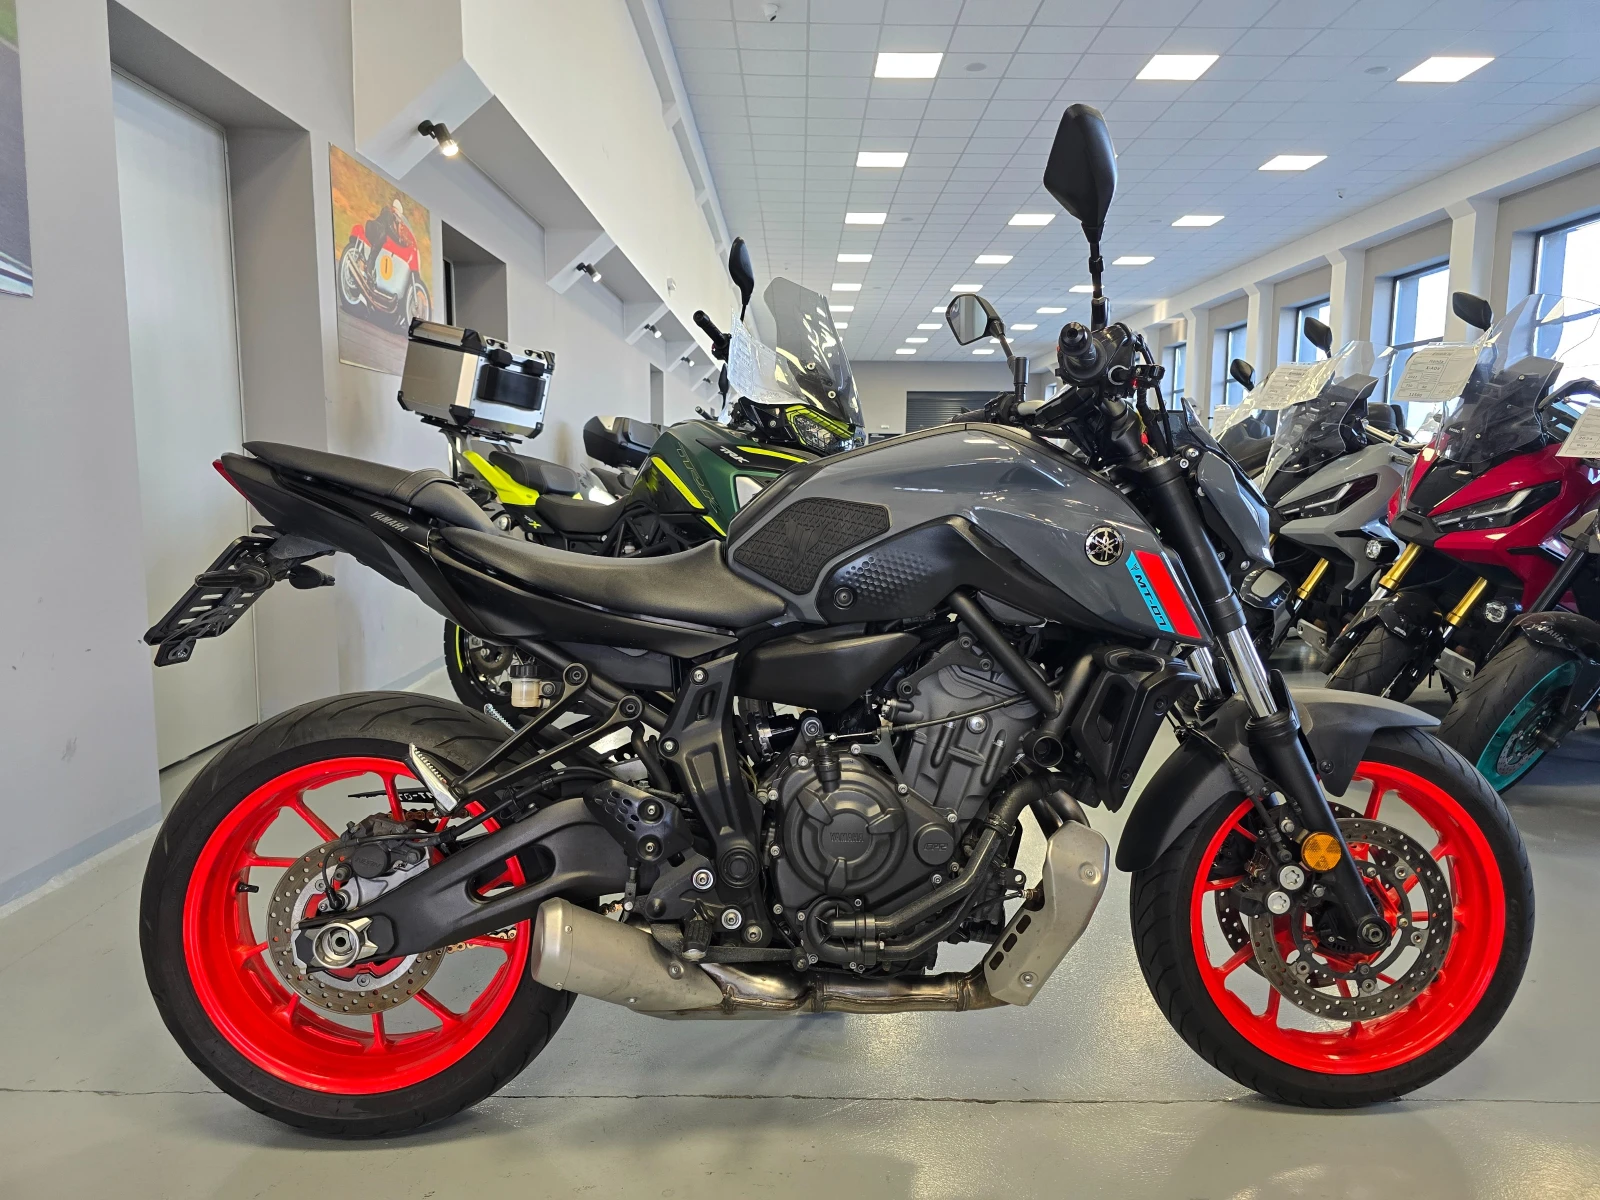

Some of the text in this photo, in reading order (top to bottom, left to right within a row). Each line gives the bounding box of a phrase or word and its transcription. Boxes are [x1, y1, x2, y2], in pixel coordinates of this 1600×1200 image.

[720, 445, 749, 463] TRK
[370, 511, 410, 532] YAMAHA
[1134, 574, 1167, 626] MT-07
[1531, 623, 1564, 642] YAMAHA
[830, 832, 864, 842] YAMAHA
